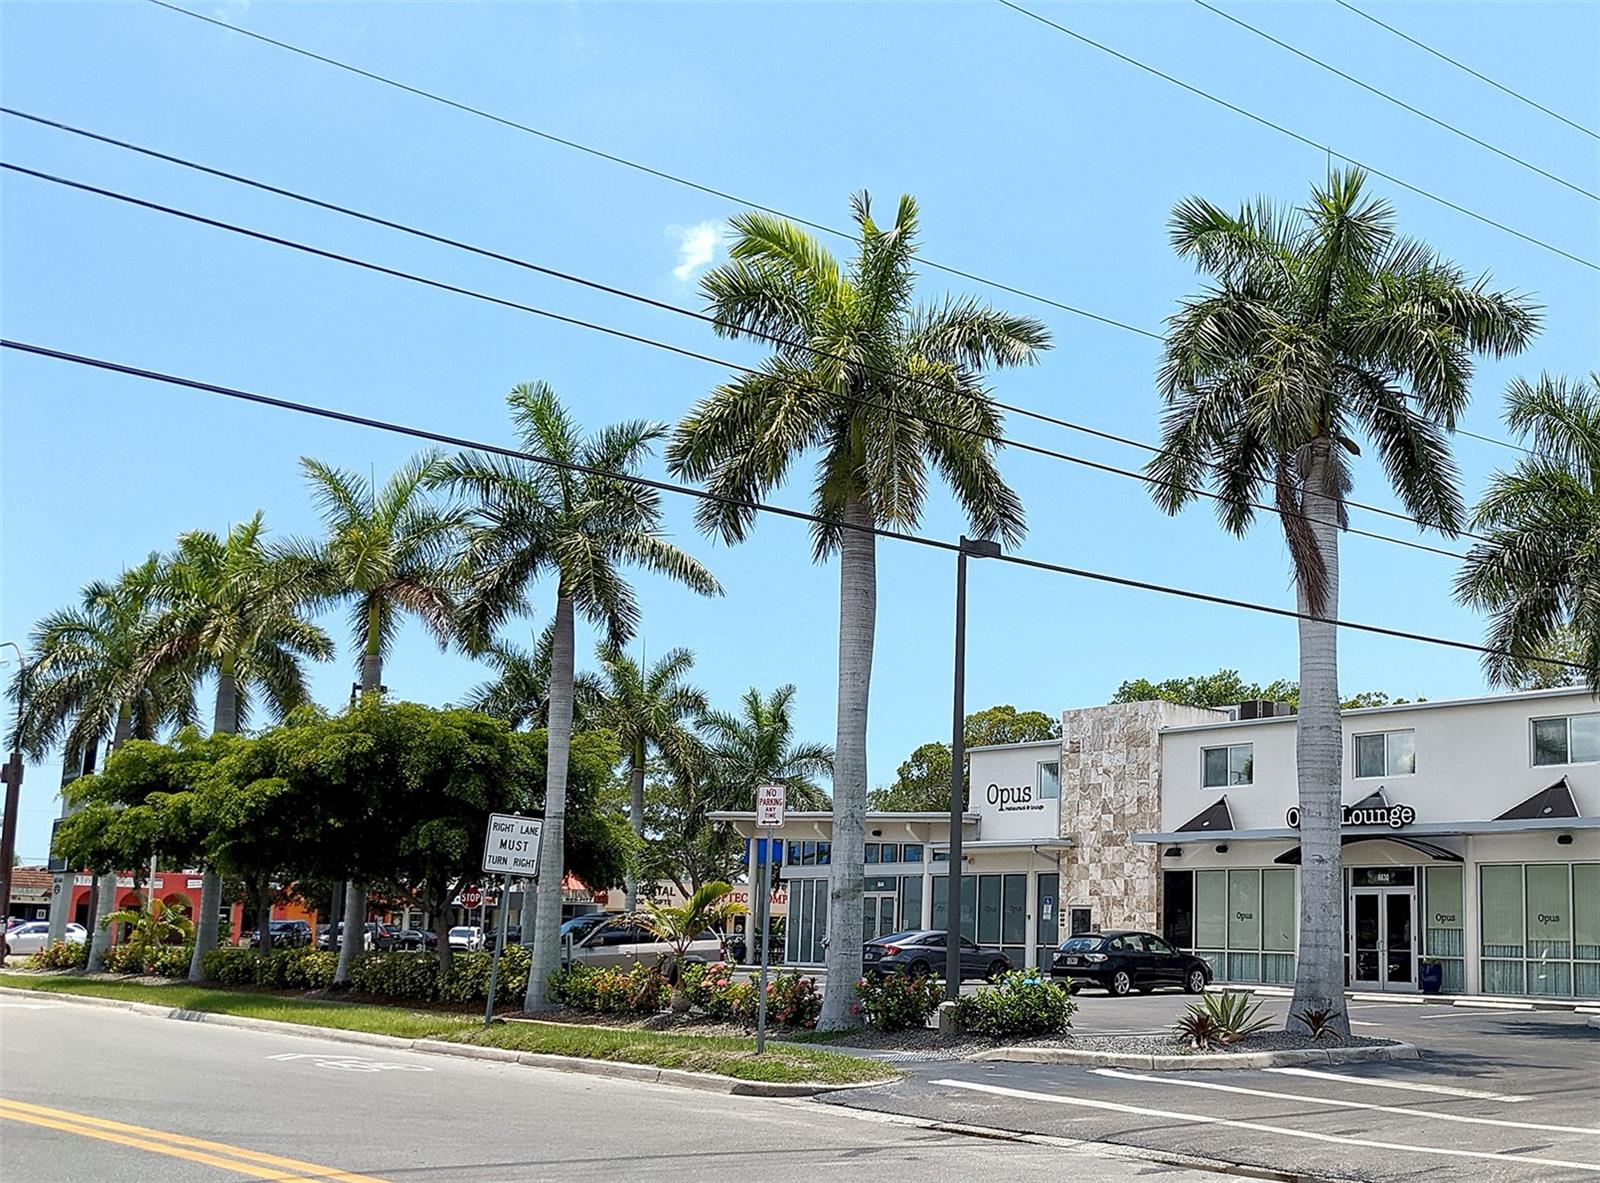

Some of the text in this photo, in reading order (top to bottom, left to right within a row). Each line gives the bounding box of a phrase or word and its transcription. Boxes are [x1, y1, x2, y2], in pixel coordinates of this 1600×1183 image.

[766, 789, 777, 797] NO
[987, 783, 1032, 811] Opus
[760, 798, 783, 807] PARKING
[1341, 806, 1413, 828] Lounge
[493, 822, 540, 836] RIGHT LANE
[499, 839, 529, 852] MUST
[488, 855, 536, 869] TURN RIGHT
[461, 892, 481, 902] STOP
[1236, 911, 1253, 921] Opus
[1435, 913, 1456, 923] Opus
[1537, 913, 1560, 924] Opus
